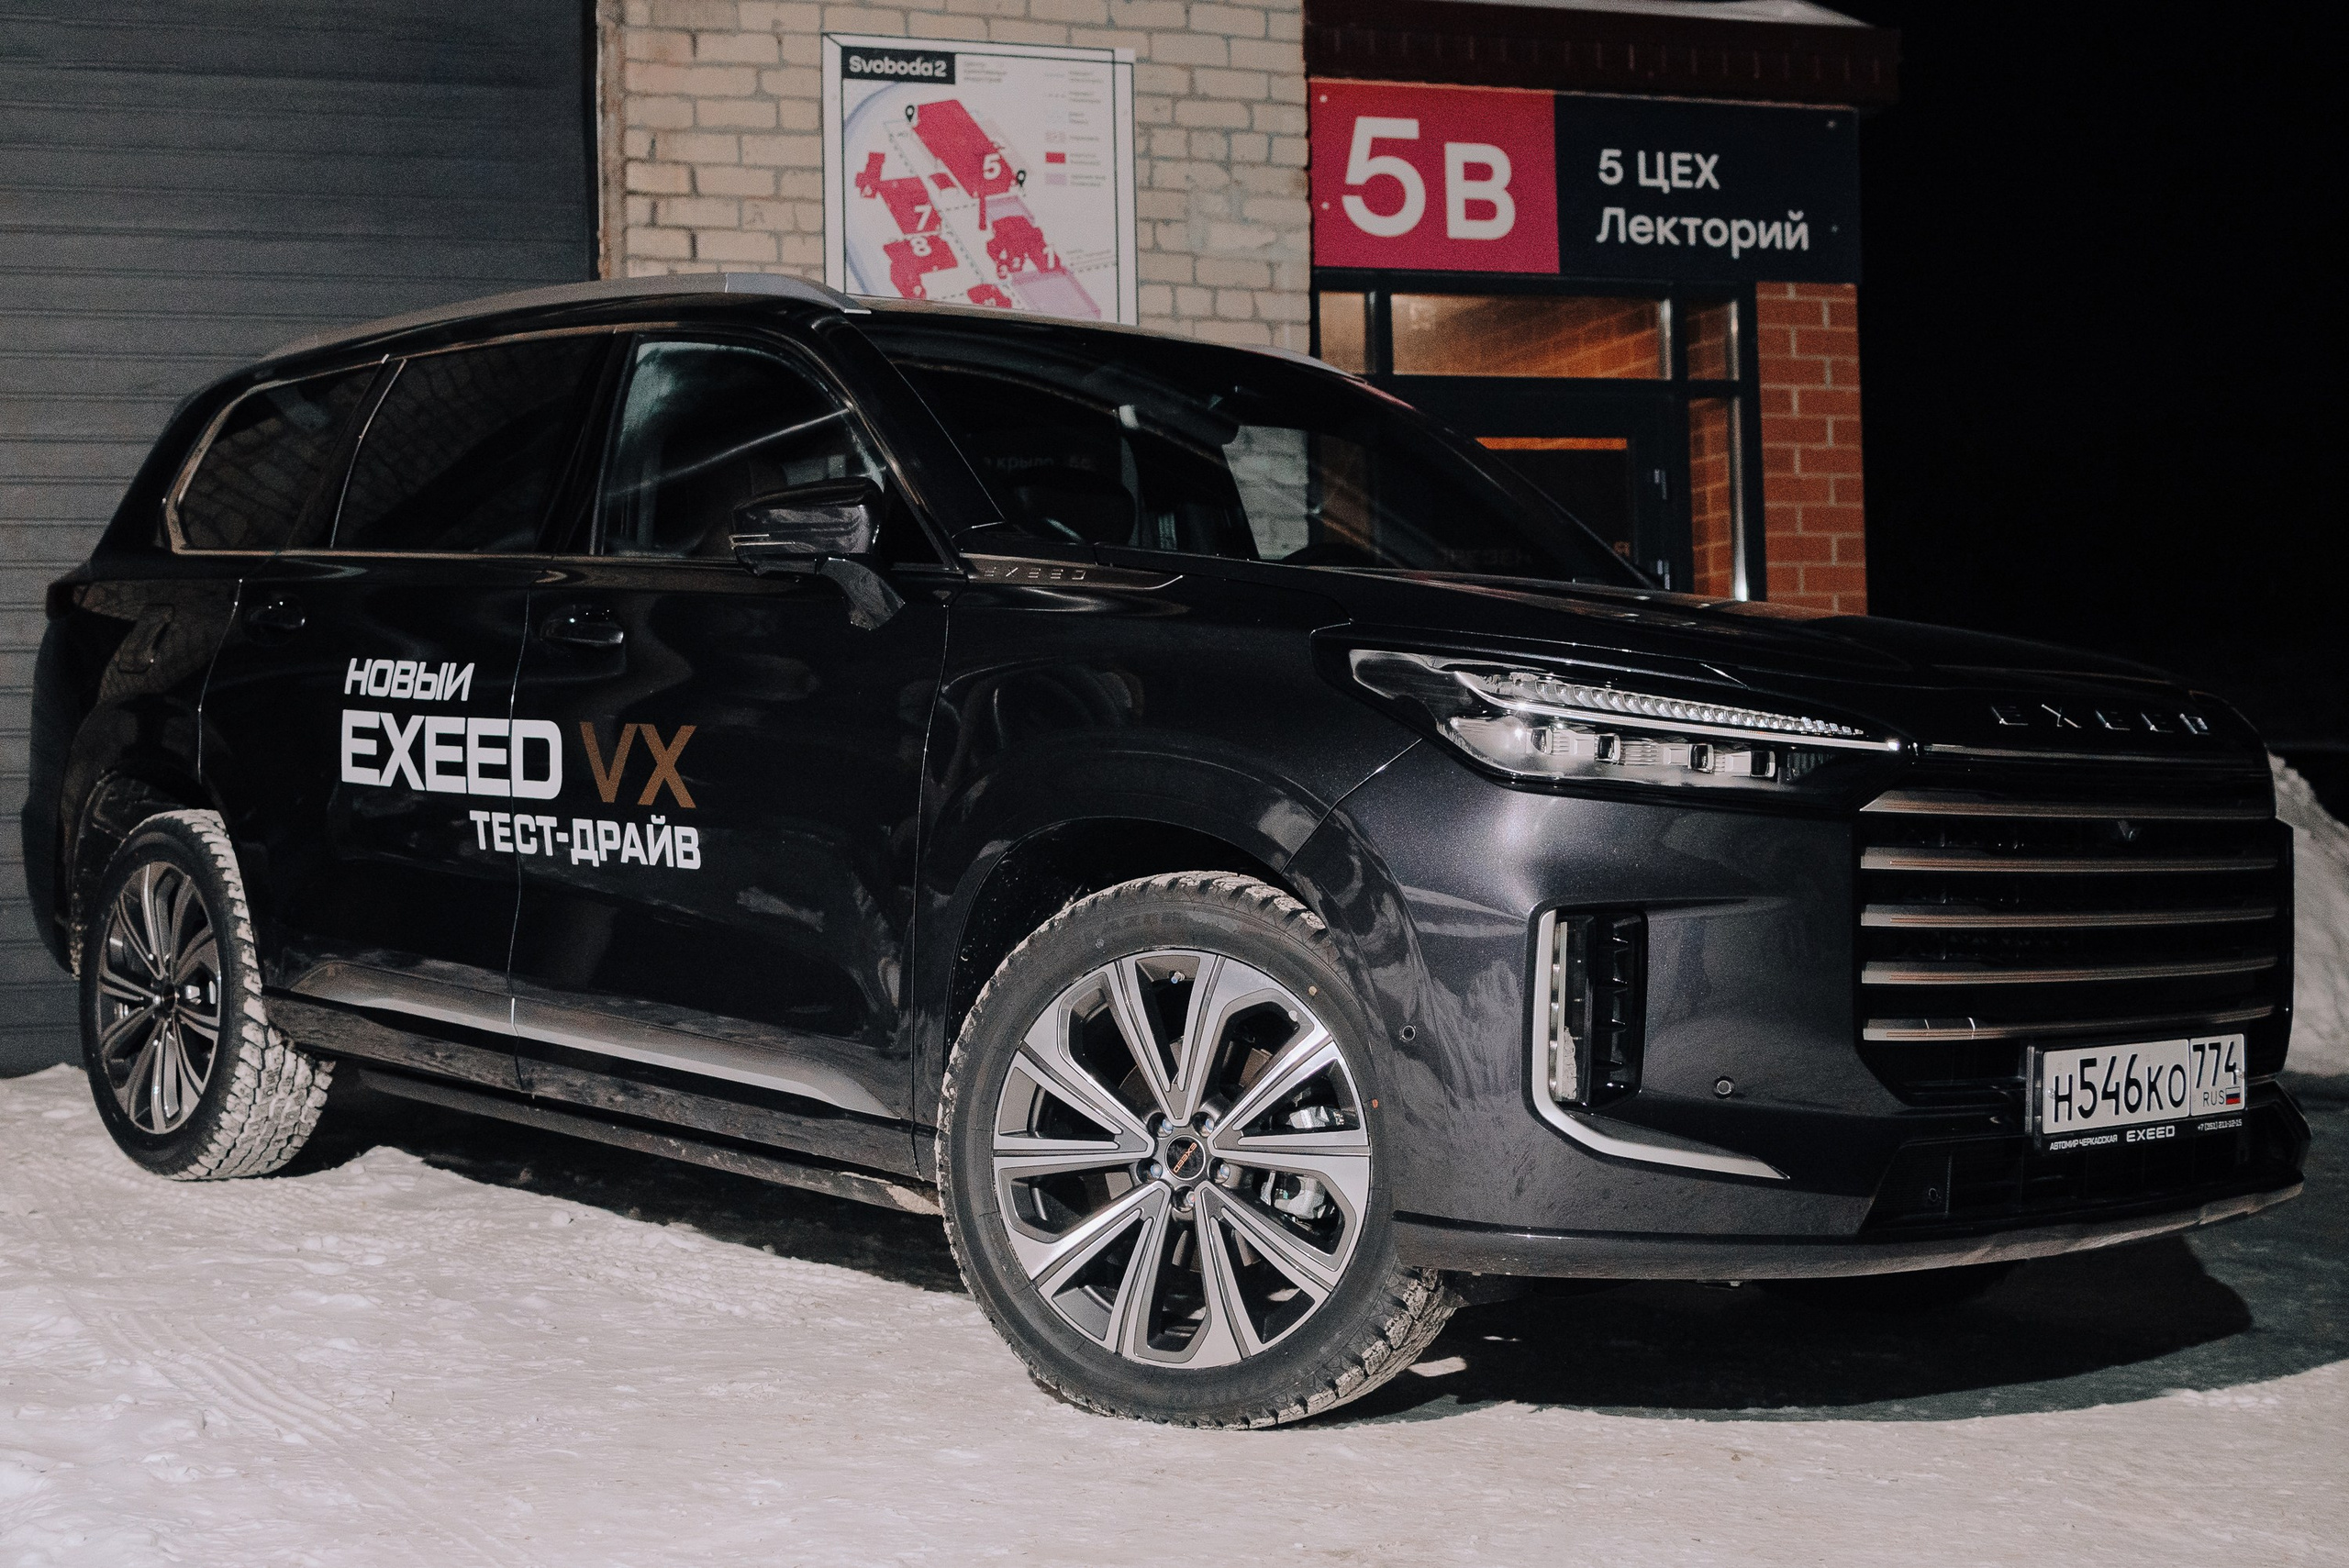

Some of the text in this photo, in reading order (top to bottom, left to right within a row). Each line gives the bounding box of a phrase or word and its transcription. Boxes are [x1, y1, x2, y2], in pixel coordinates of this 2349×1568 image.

[849, 55, 948, 78] Svoboda2
[983, 153, 1002, 181] 5
[1598, 149, 1720, 194] 5 ЦЕХ
[914, 204, 932, 230] 7
[909, 236, 932, 257] 8
[1596, 206, 1809, 260] Лекторий
[340, 709, 697, 809] EXEED VX
[469, 809, 702, 870] ТЕСТ-ДРАЙВ
[2192, 1040, 2237, 1089] 774
[2203, 1090, 2225, 1107] RUS
[2126, 1125, 2176, 1143] EXEED
[1173, 1142, 1197, 1173] EXEED
